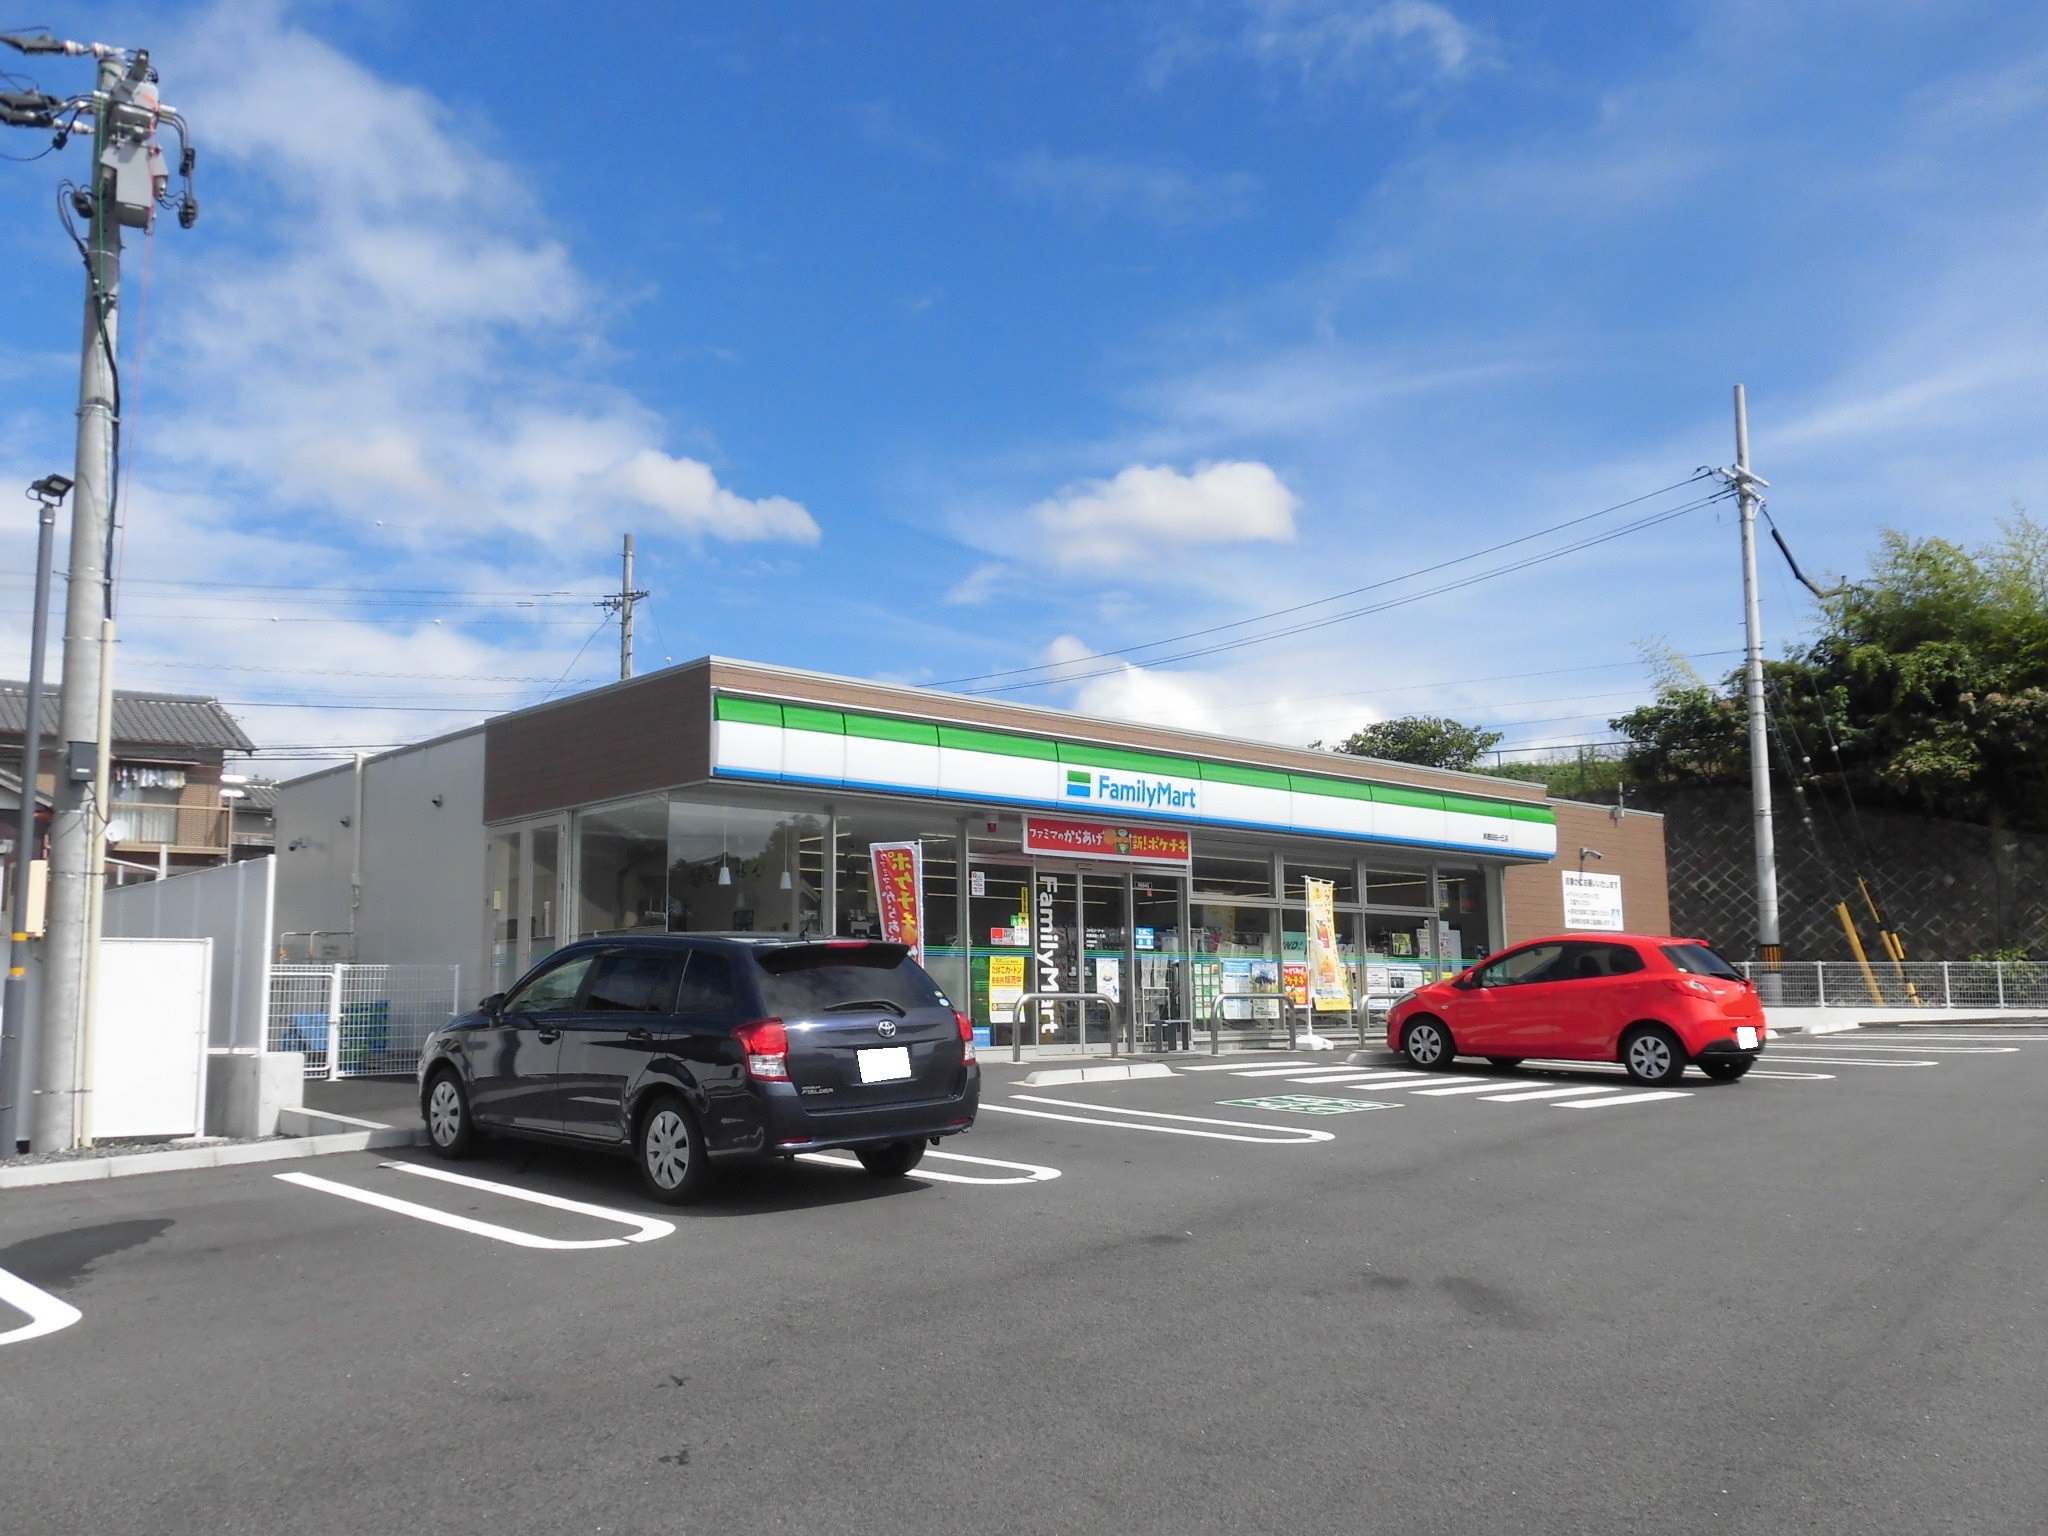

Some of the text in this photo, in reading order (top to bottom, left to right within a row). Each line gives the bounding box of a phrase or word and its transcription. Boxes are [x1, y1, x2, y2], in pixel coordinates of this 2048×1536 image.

[1099, 775, 1196, 808] FamilyMart
[1029, 828, 1105, 846] ファミマのからあげ
